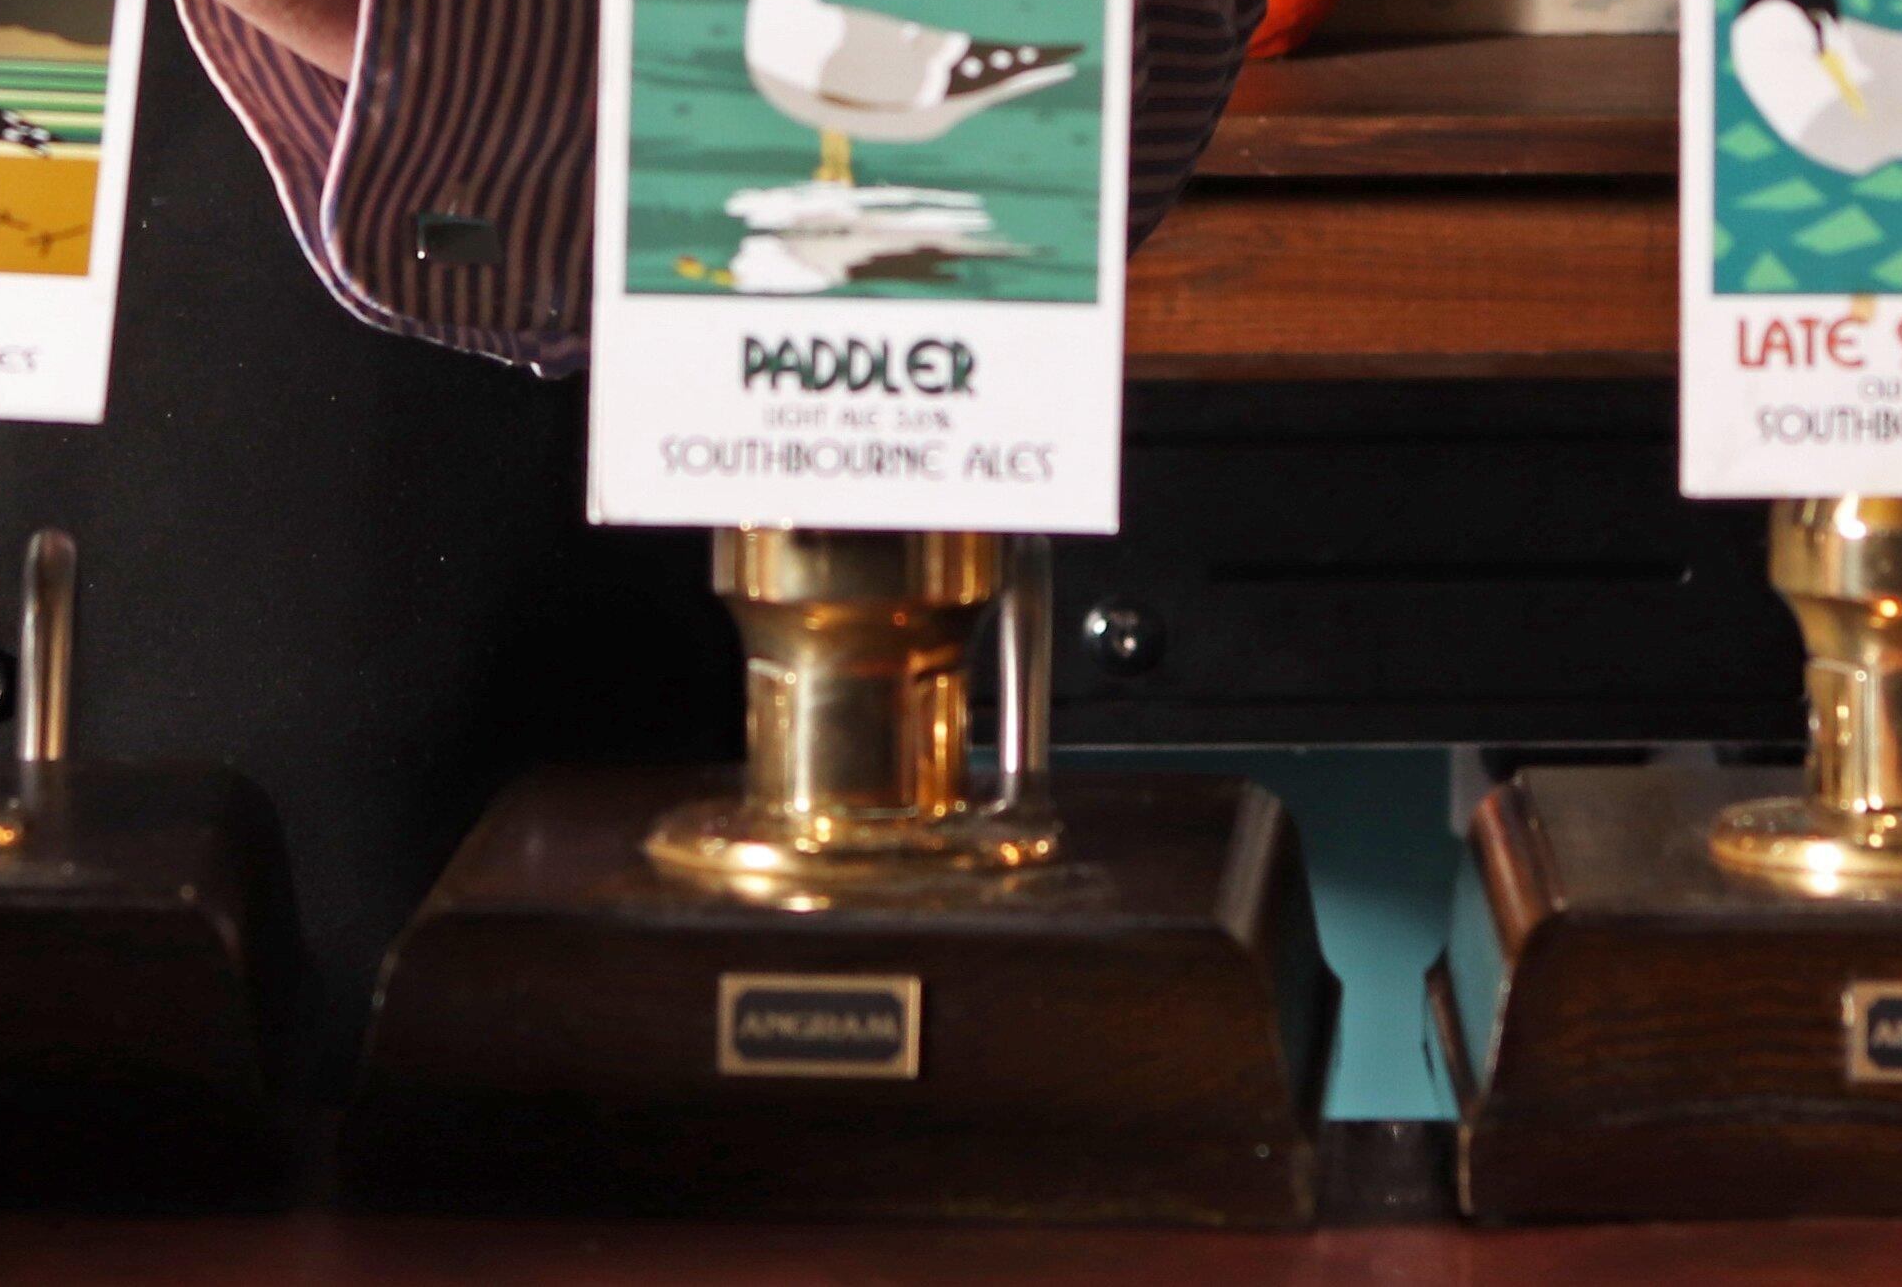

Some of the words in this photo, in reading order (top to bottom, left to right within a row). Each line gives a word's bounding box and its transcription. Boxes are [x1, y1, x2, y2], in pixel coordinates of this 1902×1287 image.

[742, 336, 978, 397] PADDLER
[1736, 316, 1866, 369] LATE
[659, 433, 947, 480] SOUTHBOURNE
[963, 441, 1057, 482] ALES
